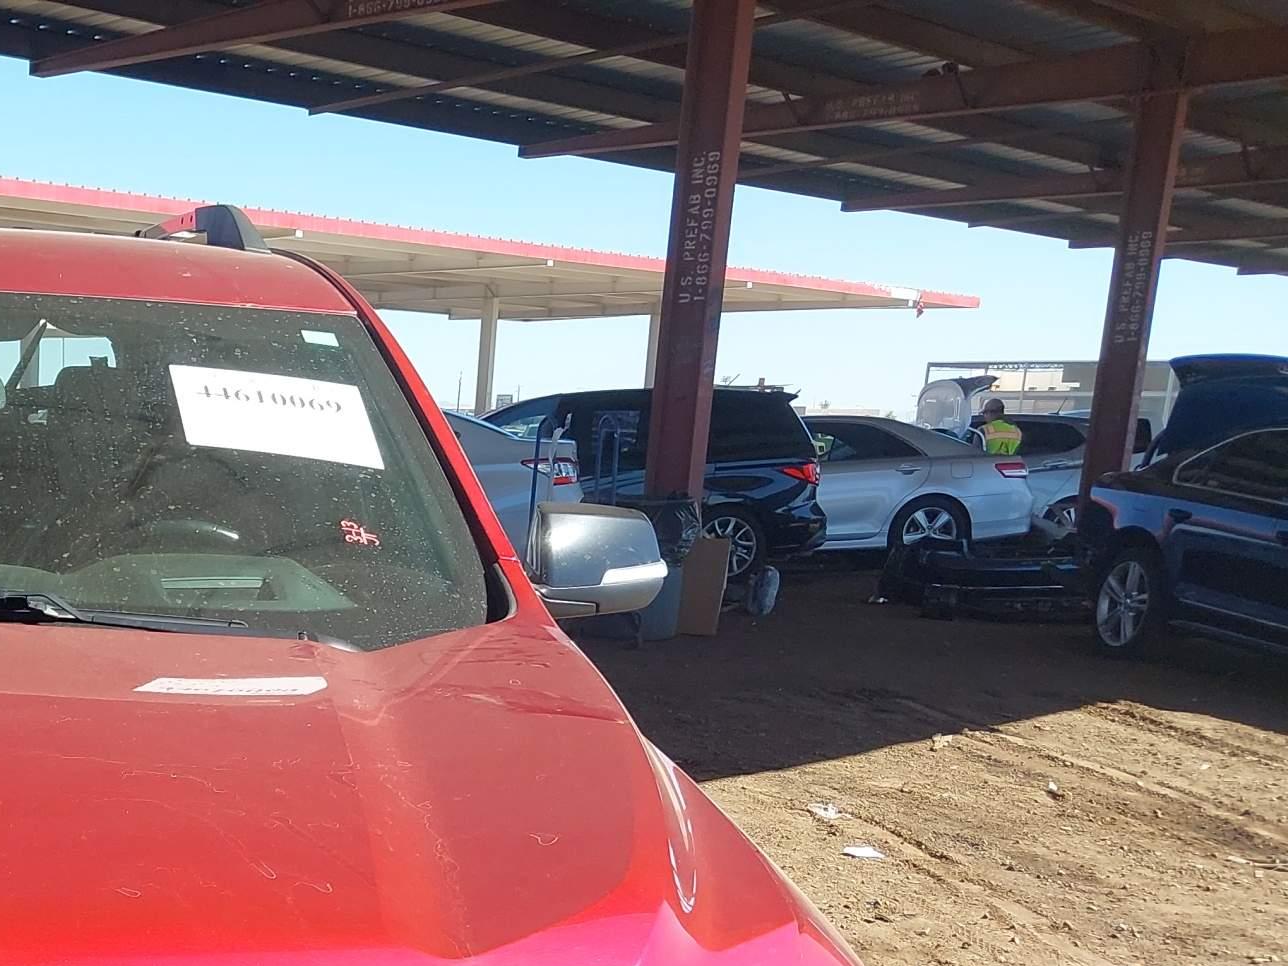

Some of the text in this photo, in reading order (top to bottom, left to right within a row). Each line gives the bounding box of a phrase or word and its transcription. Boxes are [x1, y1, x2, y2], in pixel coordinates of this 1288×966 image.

[678, 150, 707, 303] U.S. PREFAB INC.
[693, 151, 721, 302] 1-866-799-0969
[196, 384, 342, 413] 44610069
